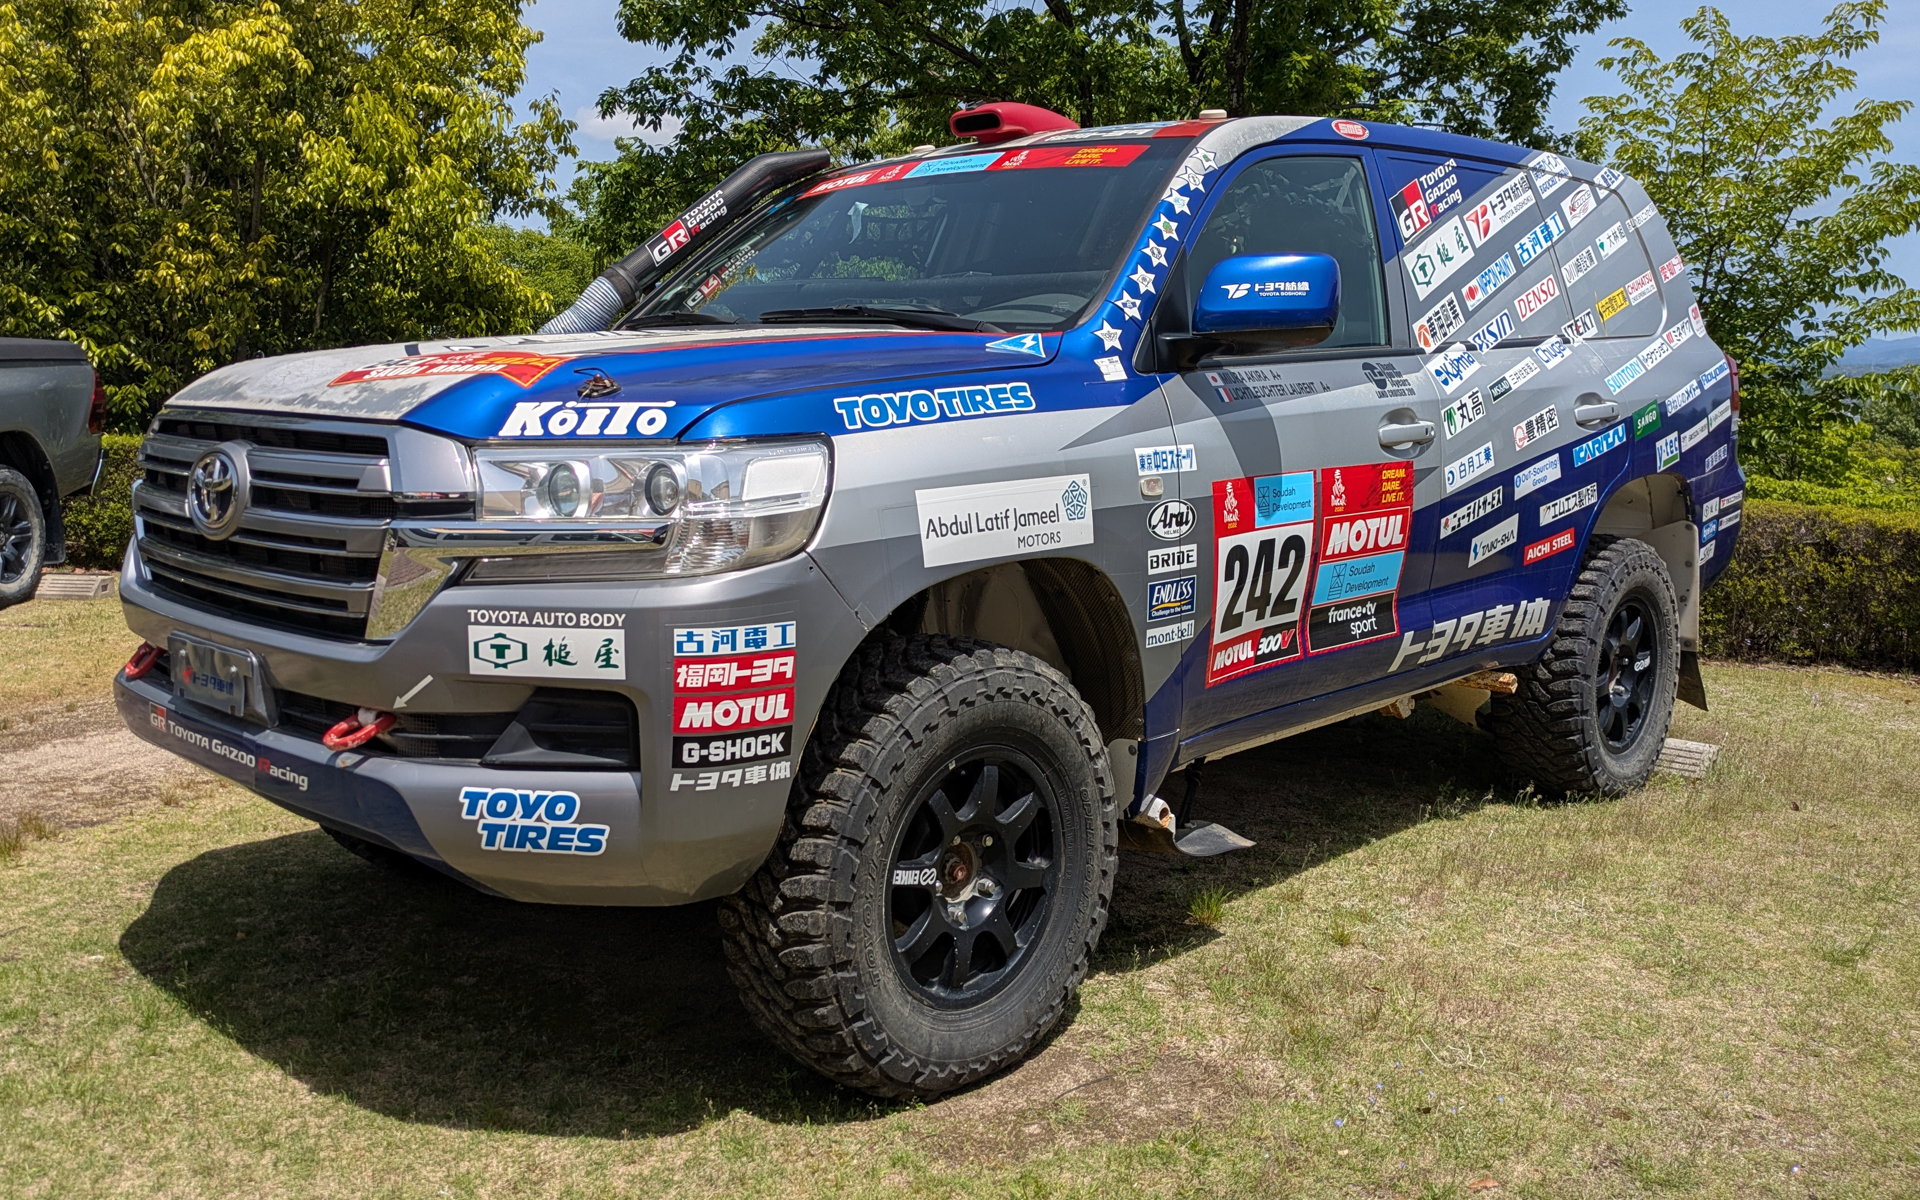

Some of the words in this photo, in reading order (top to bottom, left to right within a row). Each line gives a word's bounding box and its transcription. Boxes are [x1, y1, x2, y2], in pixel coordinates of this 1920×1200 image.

[810, 173, 870, 193] MOTUL
[1419, 158, 1457, 189] TOYOTA
[1425, 174, 1457, 204] GAZOO
[1430, 189, 1462, 218] Racing
[1489, 176, 1531, 216] トヨタ紡織
[682, 190, 723, 220] TOYOTA
[688, 198, 724, 228] GAZOO
[1399, 199, 1429, 238] GR
[1499, 209, 1515, 224] TOYOTA
[1515, 194, 1534, 213] BOSHOKU
[690, 206, 728, 236] Racing
[653, 228, 688, 262] GR
[1517, 214, 1564, 264] 古河電工
[1254, 281, 1310, 291] トヨタ紡織
[1476, 268, 1498, 298] NIPPON
[1494, 253, 1515, 282] PAINT
[1626, 271, 1653, 295] CHUHATSU
[1517, 277, 1556, 319] DENSO
[1647, 342, 1669, 363] タケショウ
[363, 367, 427, 379] SAUDI
[428, 364, 508, 374] ARABIA
[1221, 371, 1245, 384] MIURA
[1249, 370, 1268, 383] AKIRA
[1607, 360, 1643, 393] SUNTORY
[1288, 382, 1317, 395] LAURENT
[1492, 380, 1509, 396] MS&AD
[835, 389, 939, 428] TOYO
[938, 383, 1035, 415] TIRES
[1457, 390, 1485, 429] 丸高
[1637, 410, 1657, 429] SANGO
[1525, 407, 1558, 442] 豊精密
[1138, 448, 1194, 471] 東京中日スポーツ
[1382, 468, 1406, 479] DREAM.
[1458, 446, 1493, 479] 白月工業
[1272, 487, 1296, 498] Soudah
[1382, 481, 1401, 491] DARE.
[1532, 474, 1548, 487] Group
[1272, 499, 1311, 513] Development
[1382, 493, 1396, 503] LIVE
[1451, 488, 1501, 532] ニューライトサービス
[1552, 484, 1596, 519] エムエス製作所
[926, 513, 972, 539] Abdul
[976, 508, 1010, 533] Latif
[1014, 503, 1060, 531] Jameel
[1151, 504, 1192, 529] Arai
[1224, 509, 1239, 523] DAKAR
[1018, 531, 1061, 548] MOTORS
[1325, 514, 1404, 556] MOTUL
[1527, 542, 1550, 560] AICHI
[1552, 533, 1572, 551] STEEL
[1150, 549, 1195, 569] BRIDE
[1348, 563, 1375, 577] Soudah
[1152, 580, 1193, 605] ENDLESS
[1220, 535, 1306, 634] 242
[1345, 576, 1389, 595] Development
[468, 609, 529, 624] TOYOTA
[532, 612, 577, 626] AUTO
[580, 613, 626, 627] BODY
[1152, 609, 1170, 617] Challenge
[1350, 616, 1377, 639] sport
[676, 624, 795, 653] 古河電工
[1387, 597, 1551, 673] トヨタ車体
[1213, 639, 1254, 671] MOTUL
[1257, 629, 1295, 657] 300V
[676, 656, 793, 688] 福岡トヨタ
[679, 693, 790, 728] MOTUL
[150, 714, 166, 731] GR
[168, 720, 209, 750] TOYOTA
[212, 739, 255, 768] GAZOO
[258, 758, 308, 791] Racing
[682, 732, 785, 763] G-SHOCK
[670, 761, 791, 792] トヨタ車体
[462, 790, 577, 821] TOYO
[480, 823, 607, 852] TIRES
[892, 869, 920, 885] ENKEI
